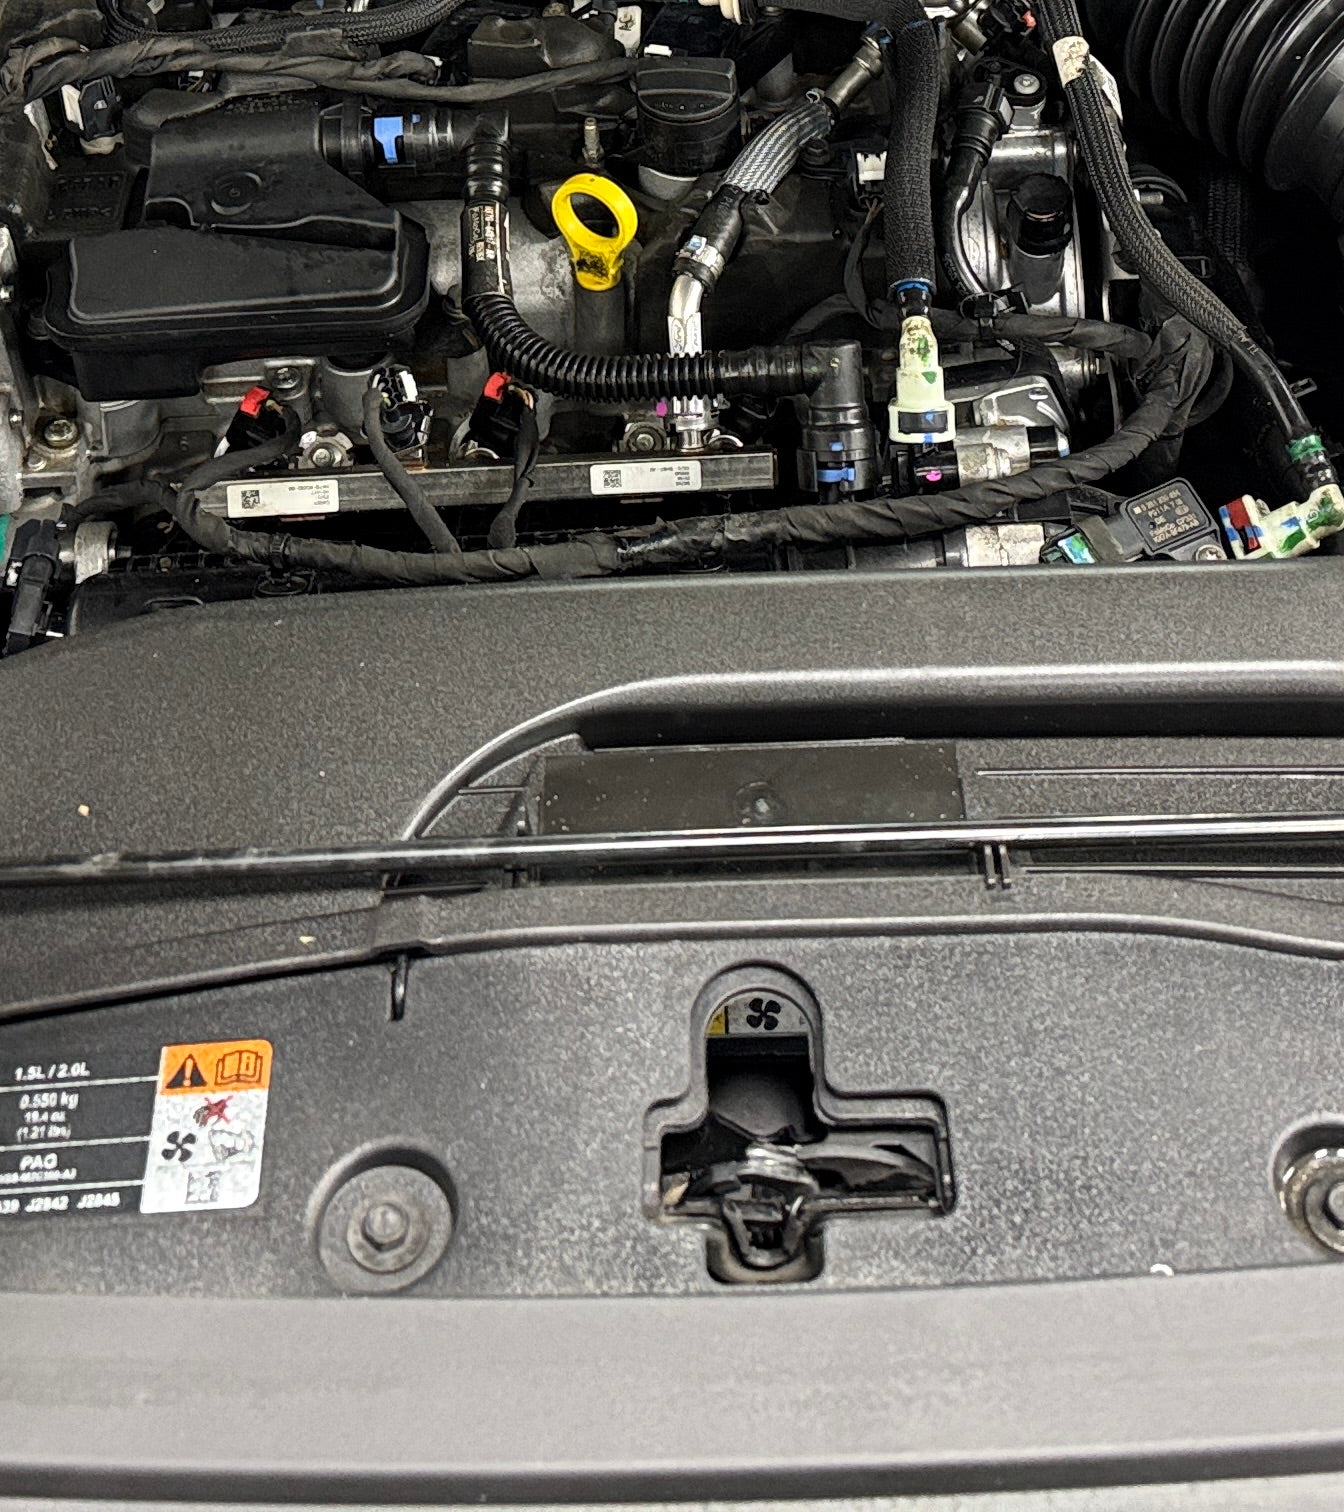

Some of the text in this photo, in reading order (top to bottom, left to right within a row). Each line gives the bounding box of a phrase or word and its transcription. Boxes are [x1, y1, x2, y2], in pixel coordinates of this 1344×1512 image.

[14, 1065, 46, 1082] 1.5L
[56, 1062, 91, 1079] 2.0L
[19, 1090, 80, 1110] 0.550 kg
